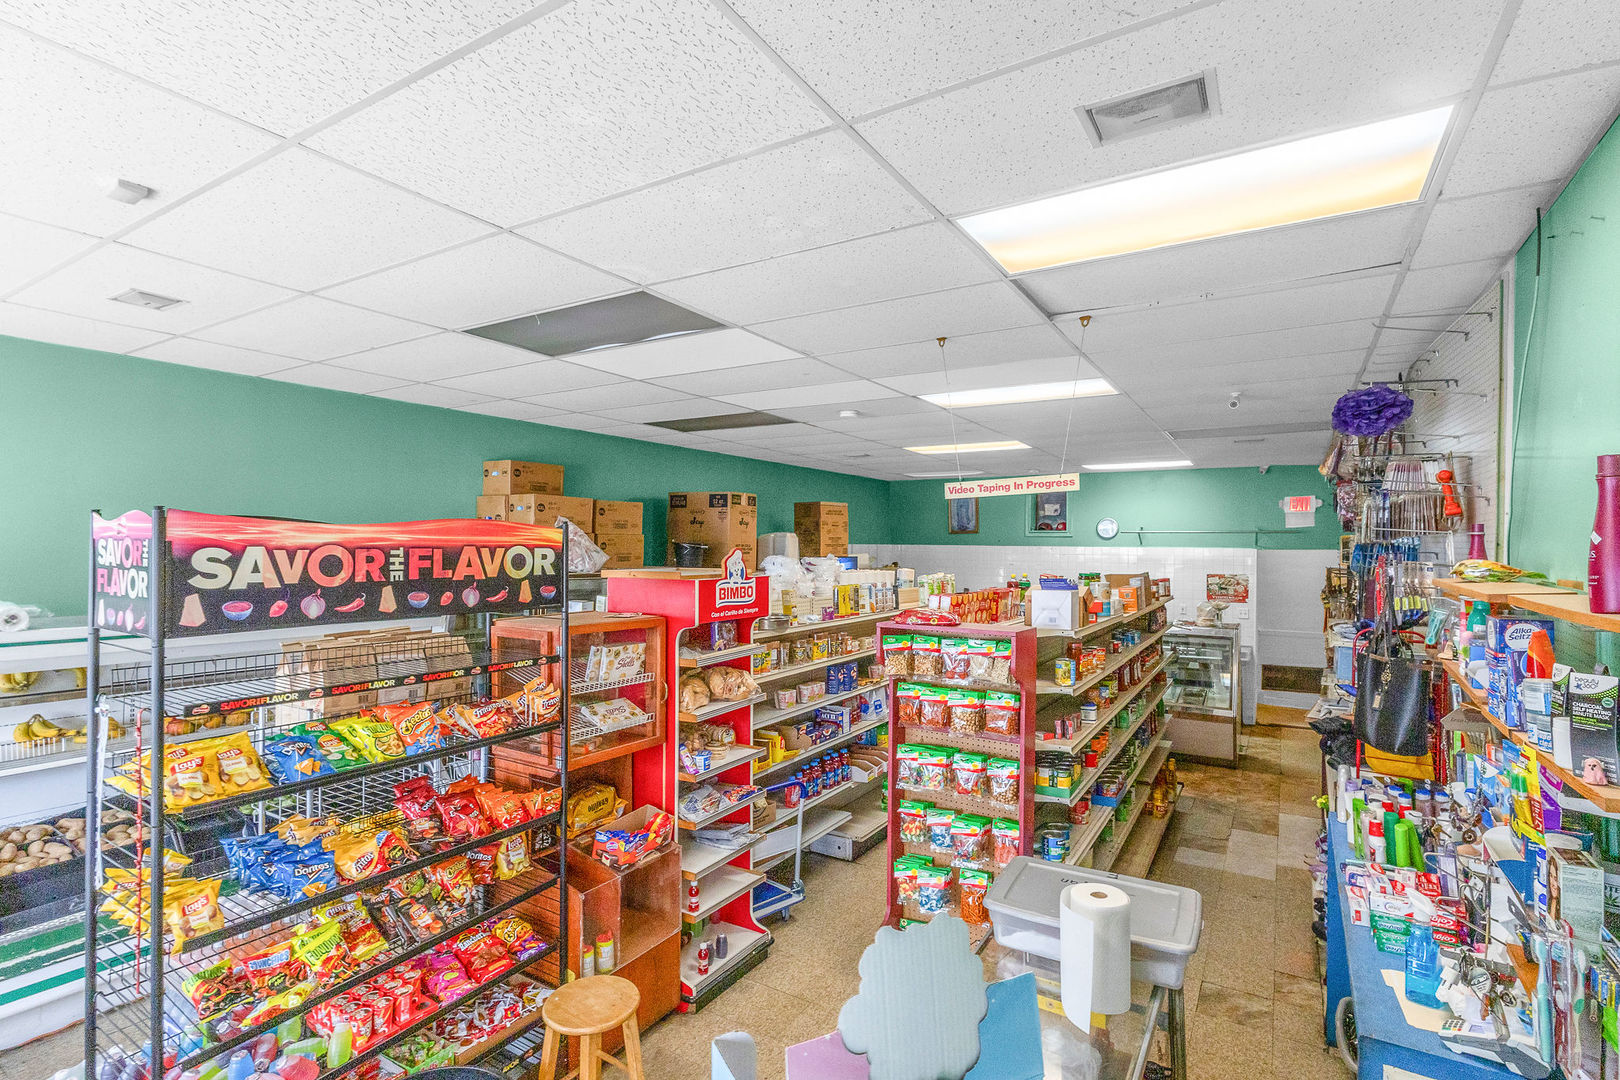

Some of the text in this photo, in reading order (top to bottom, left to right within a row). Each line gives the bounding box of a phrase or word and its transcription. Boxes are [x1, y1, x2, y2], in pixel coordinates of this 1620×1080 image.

[947, 478, 1076, 495] Video Taping In Progress
[1289, 496, 1312, 512] EXIT
[97, 537, 143, 568] SAVOR
[187, 544, 556, 591] SAVOR THE FLAVOR
[97, 567, 148, 600] FLAVOR
[718, 585, 754, 601] BIMBO
[422, 672, 447, 682] SAVOR
[331, 684, 362, 695] SAVOR
[220, 699, 258, 712] SAVOR
[1572, 701, 1604, 710] CHARCOAL
[1586, 708, 1612, 716] HEATING
[400, 708, 431, 736] Cheetos
[1593, 713, 1611, 721] MASK
[216, 748, 242, 760] Lay's
[174, 757, 205, 772] Lay's
[294, 862, 330, 877] Doritos
[353, 852, 375, 873] Fritos
[184, 896, 210, 917] Lay's
[248, 949, 291, 971] MUNCHIES
